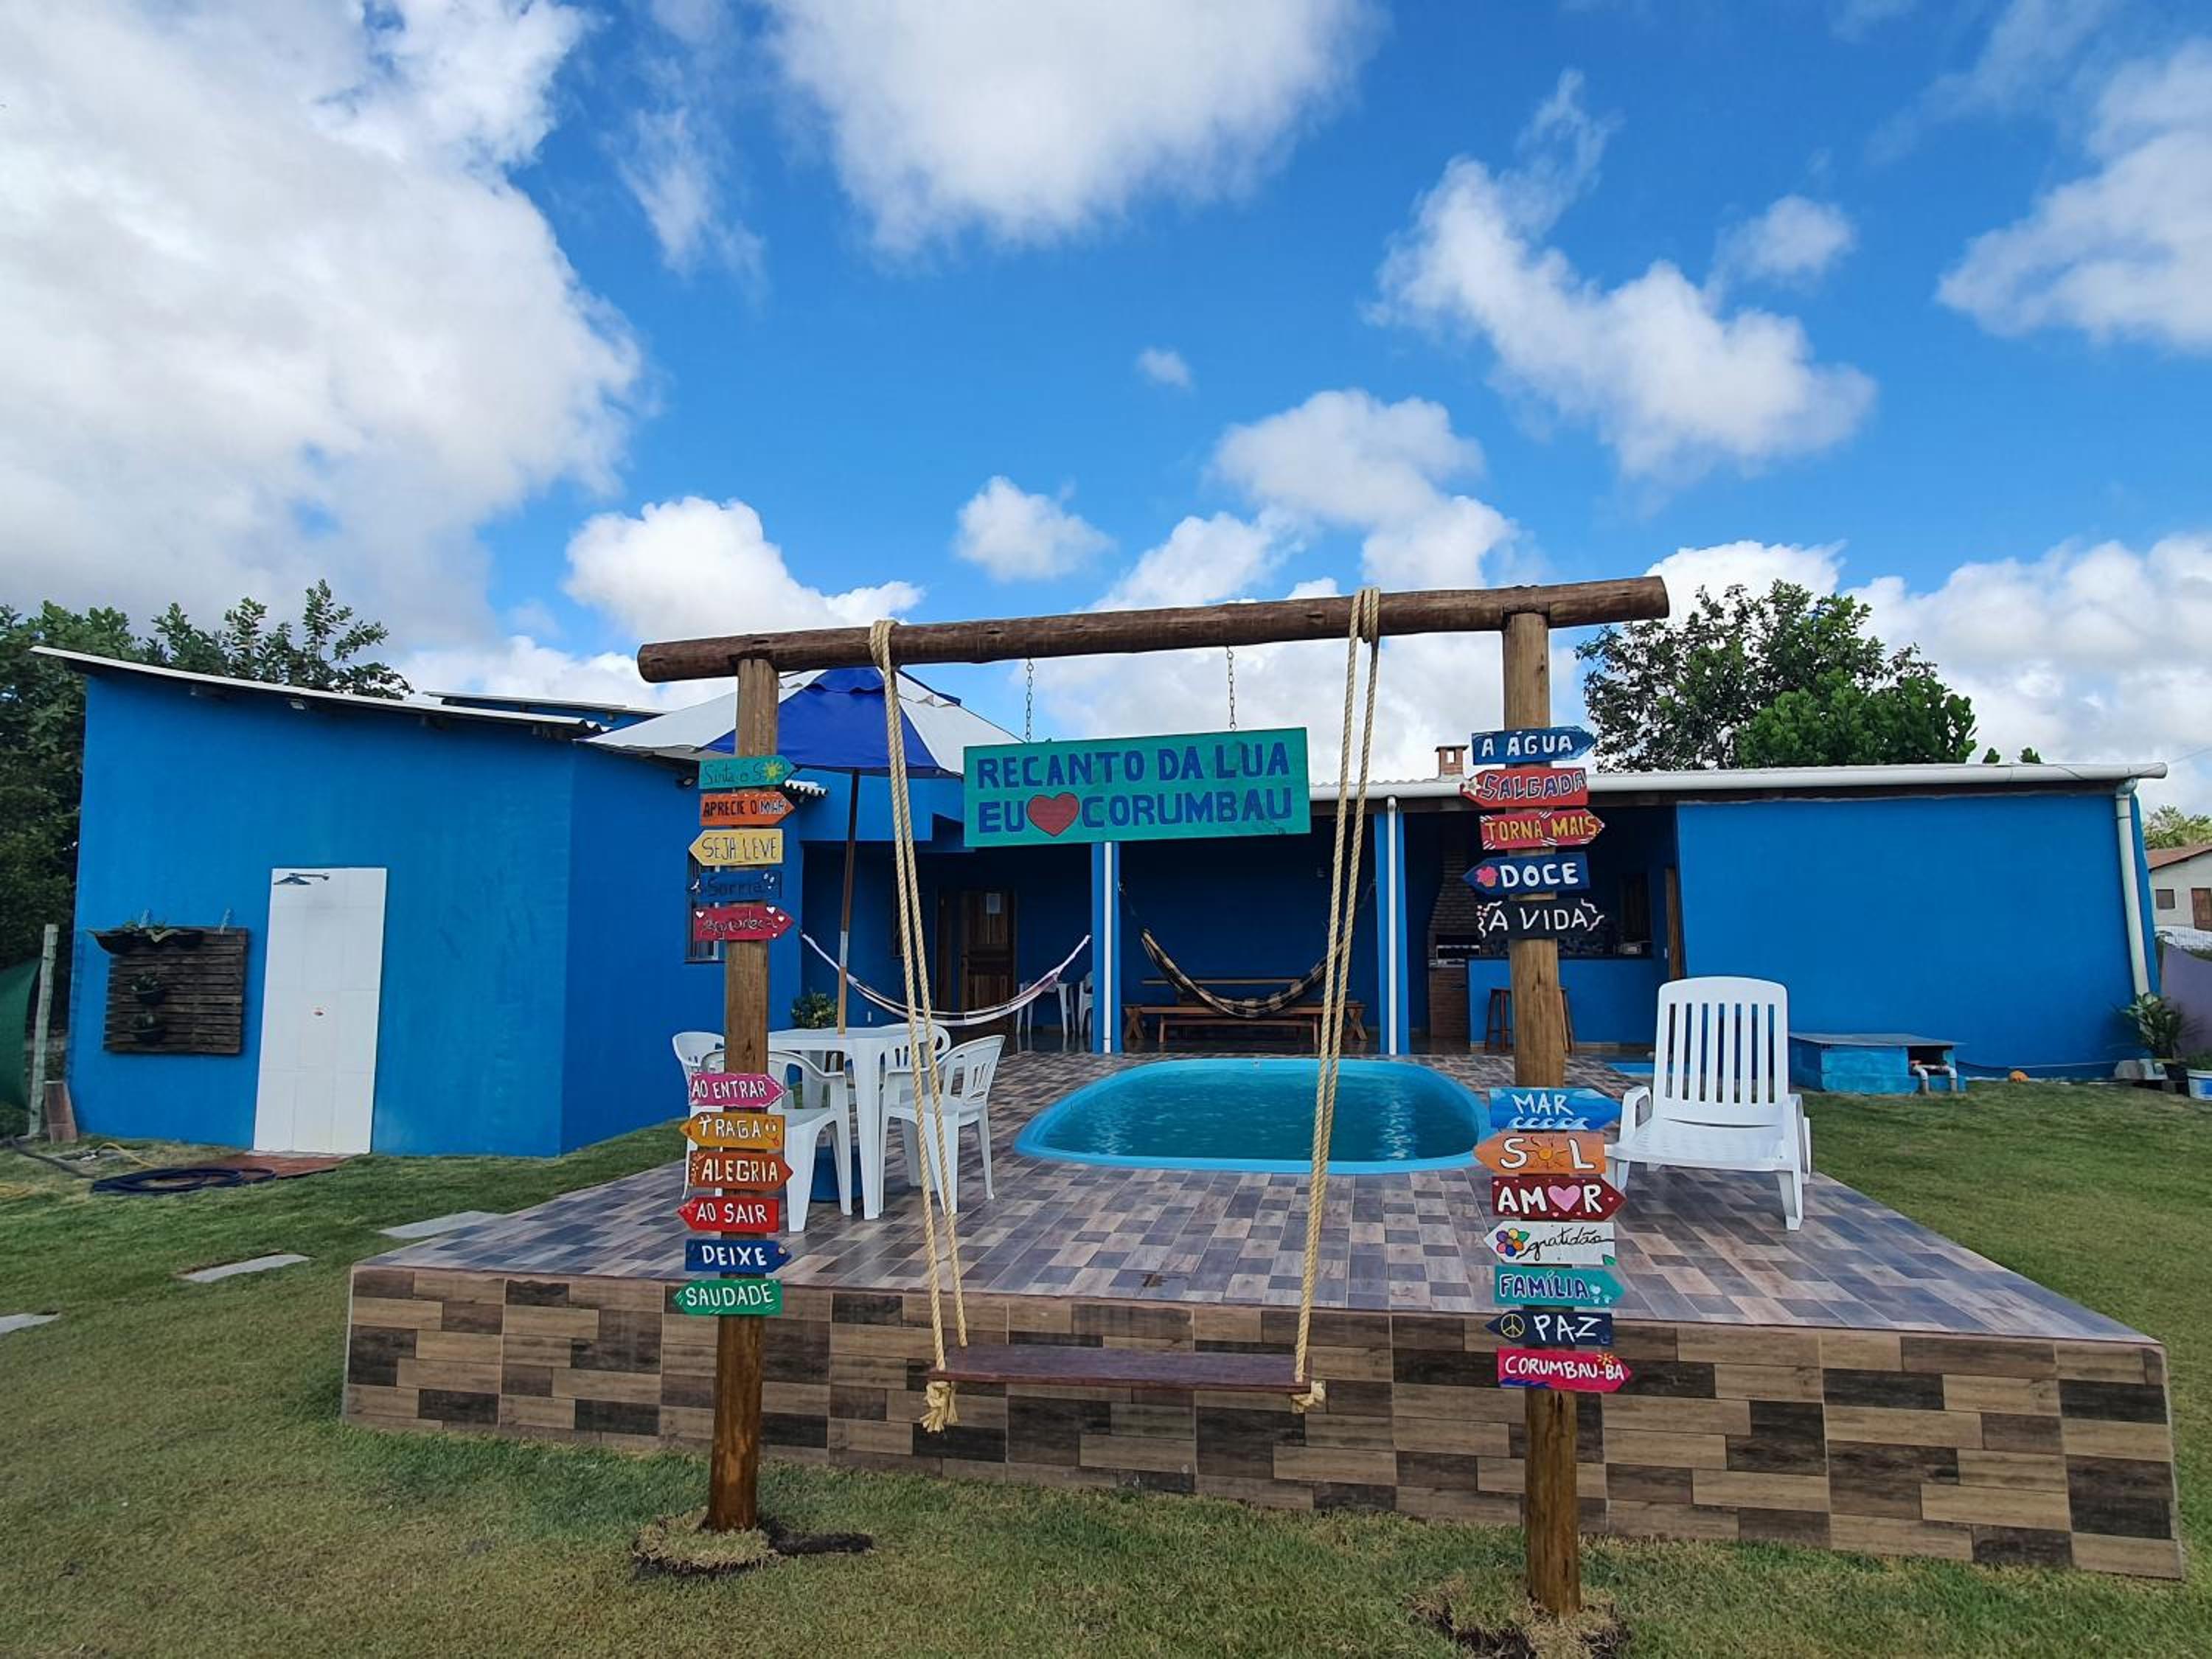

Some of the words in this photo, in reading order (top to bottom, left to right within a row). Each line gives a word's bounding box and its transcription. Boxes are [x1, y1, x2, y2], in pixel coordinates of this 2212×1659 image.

[1481, 738, 1495, 757] A
[976, 748, 1145, 790] RECANTO
[1157, 745, 1205, 782] DA
[1214, 742, 1290, 780] LUA
[1479, 770, 1587, 800] SALGADA
[703, 800, 745, 817] APRECIE
[750, 799, 757, 815] O
[978, 799, 1026, 834] EU
[1081, 787, 1293, 829] CORUMBAU
[1485, 820, 1544, 841] TORNA
[1551, 816, 1598, 838] MAIS
[701, 837, 737, 860] SEJA
[742, 837, 777, 860] LEVE
[1499, 862, 1579, 888] DOCE
[1488, 908, 1509, 931] A
[1520, 907, 1588, 931] VIDA
[691, 1079, 709, 1099] AO
[712, 1079, 768, 1099] ENTRAR
[1512, 1093, 1575, 1116] MAR
[698, 1114, 762, 1139] TRAGA
[701, 1158, 779, 1183] ALEGRIA
[696, 1203, 717, 1222] AO
[724, 1203, 768, 1224] SAIR
[702, 1245, 768, 1266] DEIXE
[1516, 1227, 1615, 1262] gratidão
[685, 1283, 775, 1307] SAUDADE
[1499, 1270, 1591, 1298] FAMÍLIA
[1534, 1314, 1602, 1343] PAZ
[1505, 1355, 1625, 1381] CORUMBAU-BA
